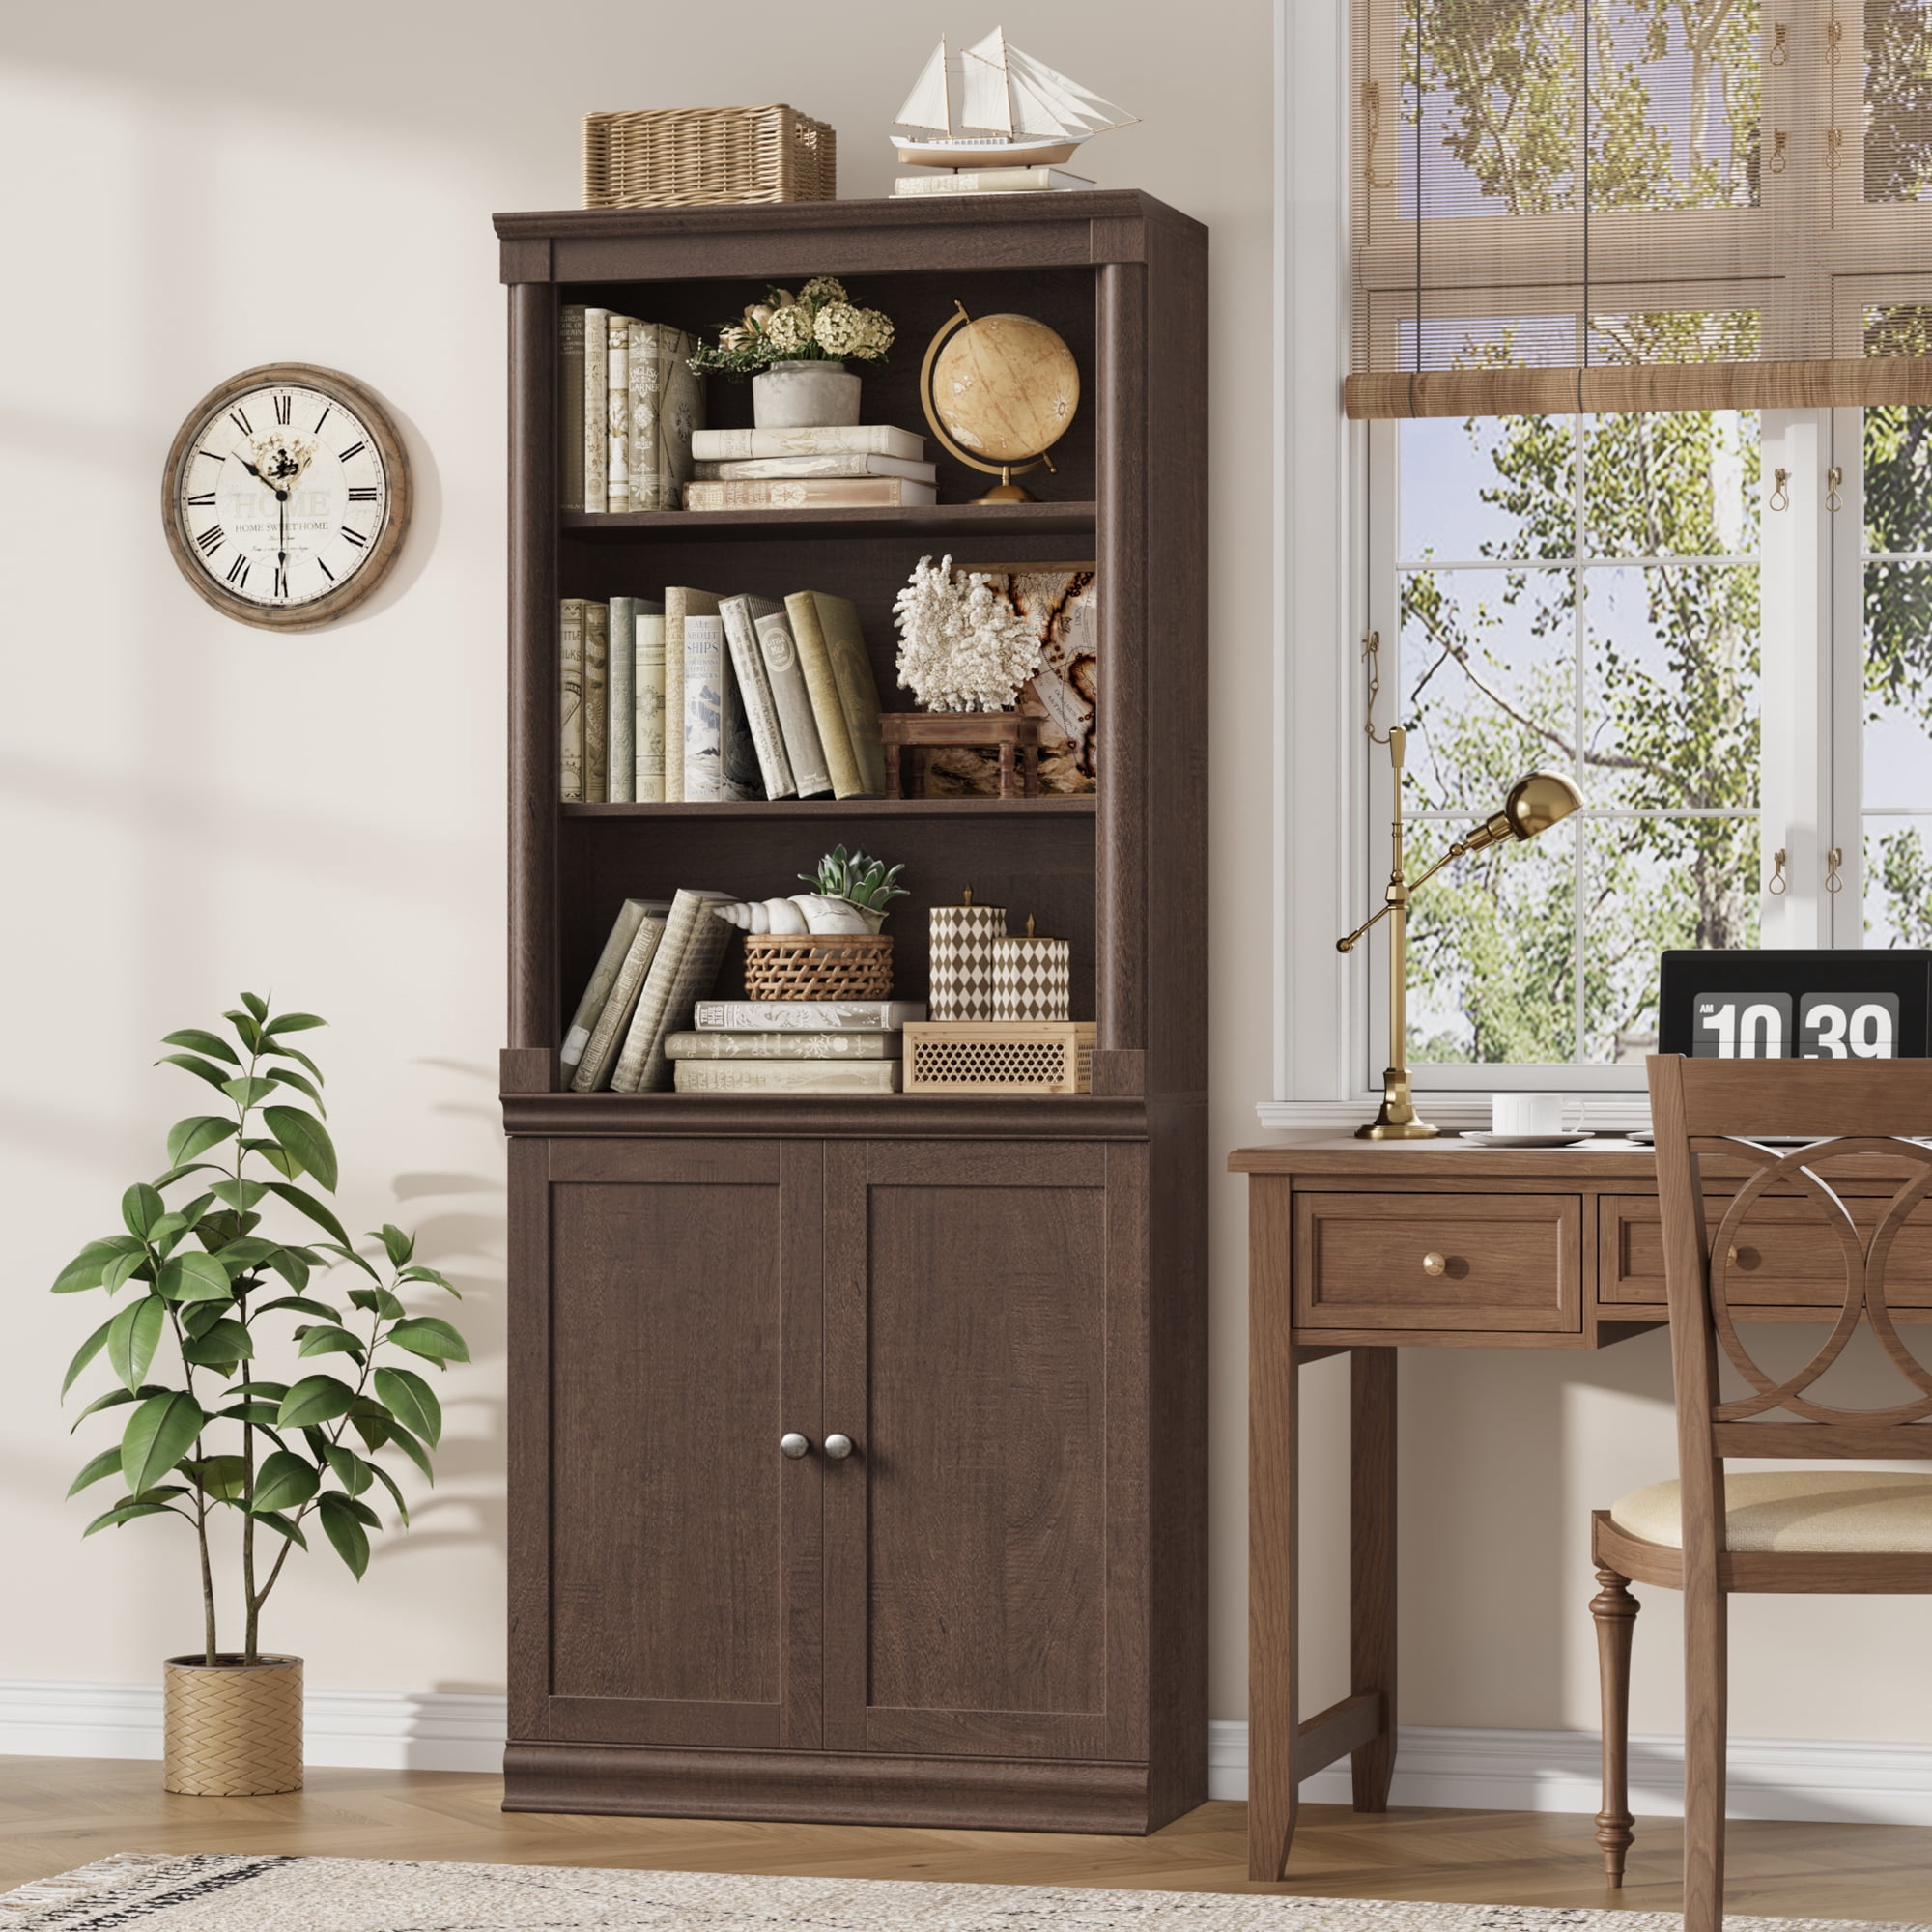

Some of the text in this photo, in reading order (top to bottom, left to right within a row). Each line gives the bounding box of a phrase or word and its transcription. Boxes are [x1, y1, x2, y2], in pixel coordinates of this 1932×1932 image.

[235, 522, 329, 533] HOME SWET HOME
[687, 631, 720, 639] ABOUT
[687, 641, 719, 655] SHIPS
[707, 1006, 716, 1025] BLUE
[1700, 1004, 1714, 1013] AM
[715, 1006, 724, 1026] BIRD
[1703, 1004, 1893, 1059] 10 39
